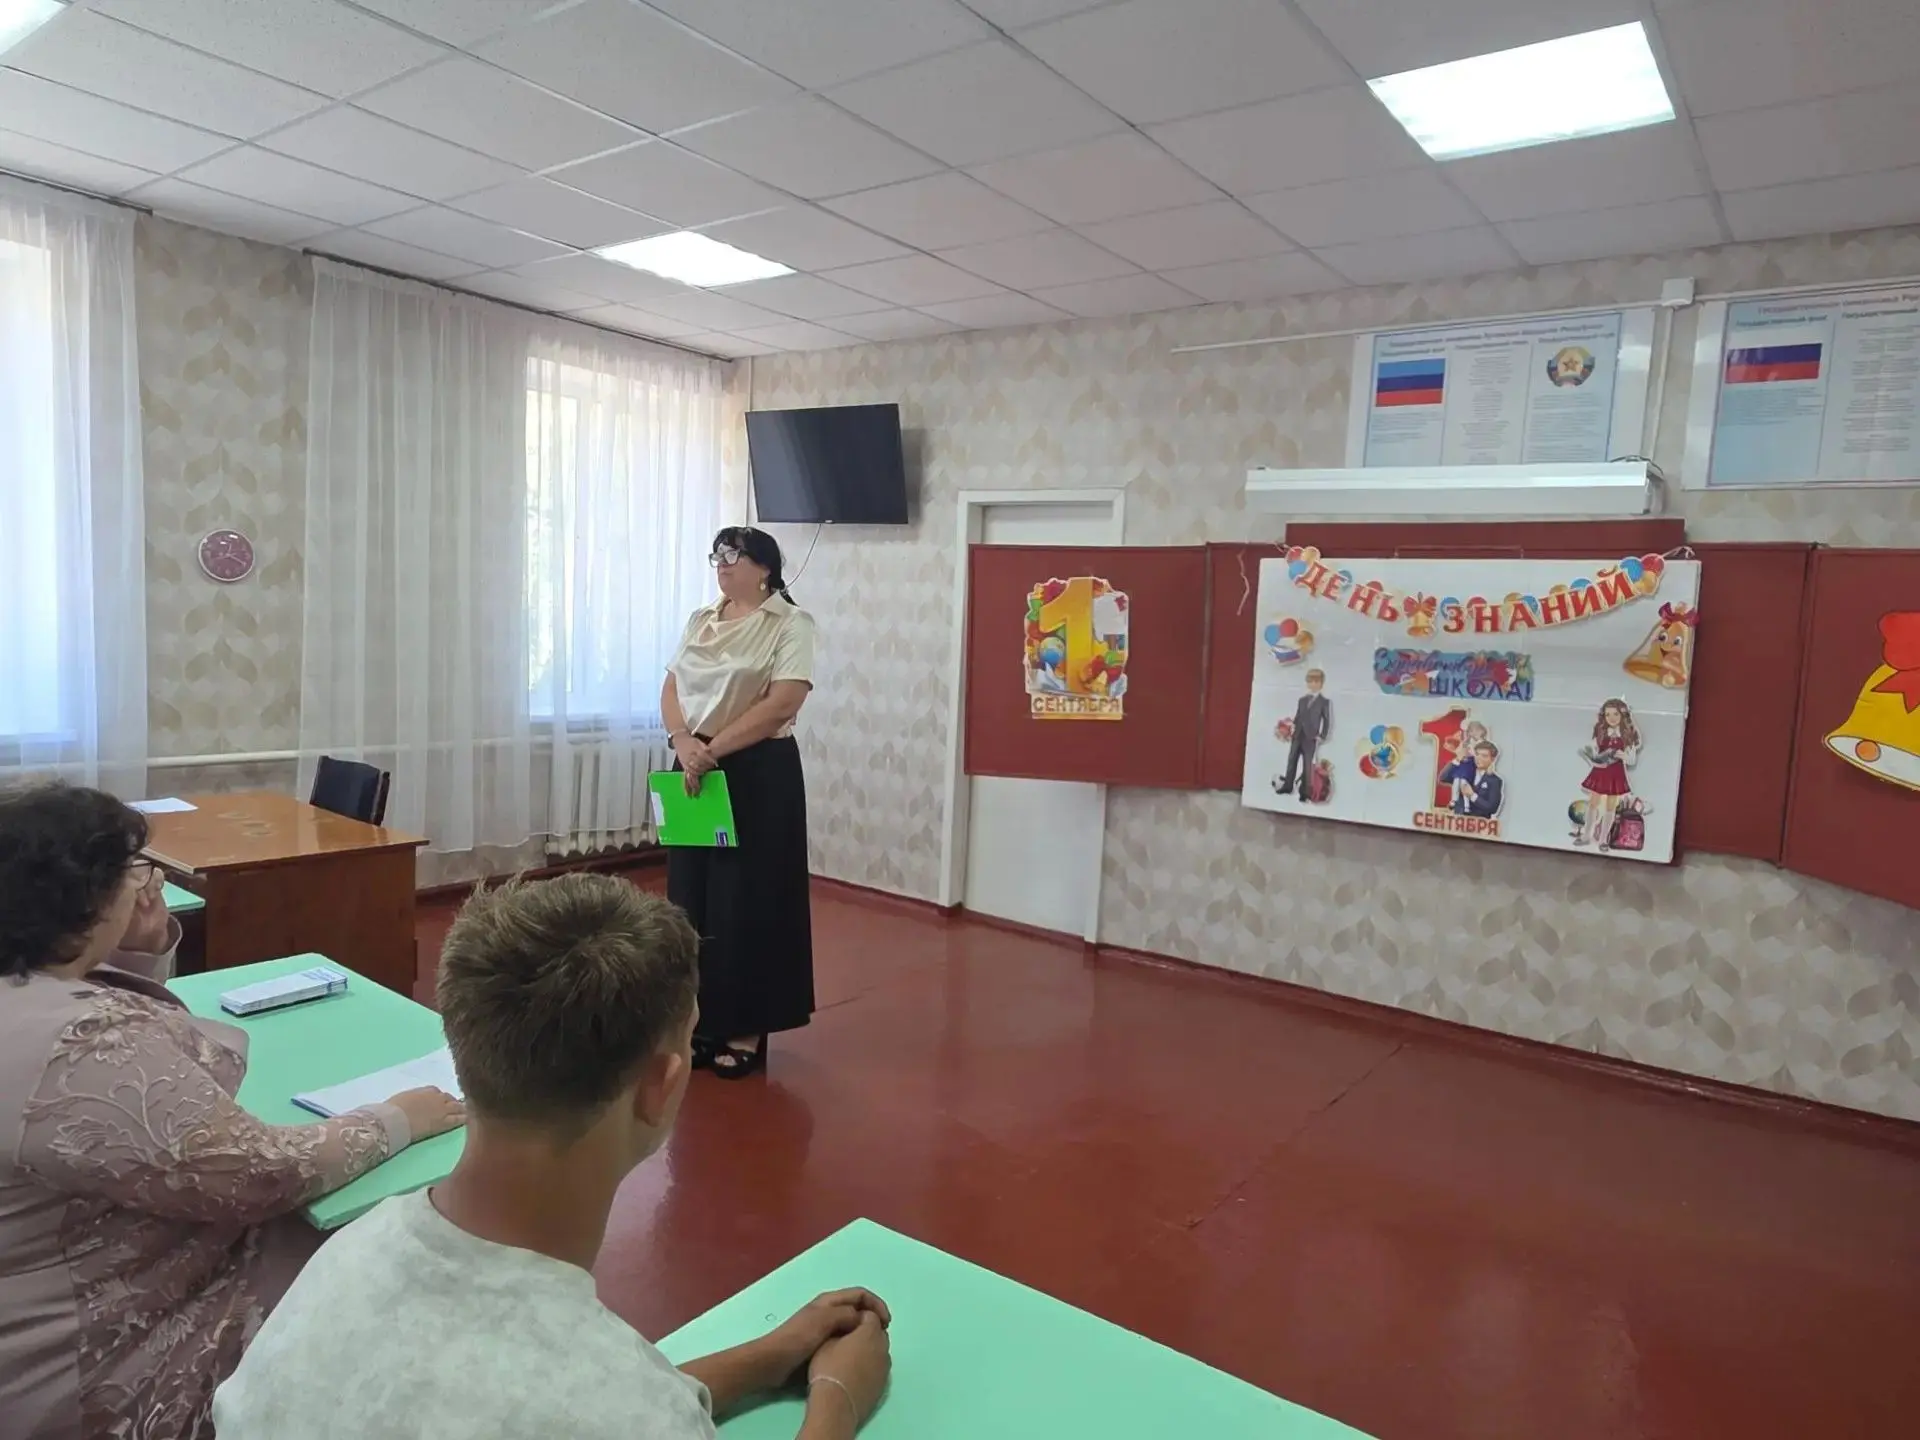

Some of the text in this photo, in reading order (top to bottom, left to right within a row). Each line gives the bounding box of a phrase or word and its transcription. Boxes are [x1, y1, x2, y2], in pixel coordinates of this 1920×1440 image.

[1295, 561, 1636, 634] ДЕНЬ ЗНАНИЙ
[1040, 578, 1093, 692] 1
[1032, 696, 1121, 713] СЕНТЯБРЯ
[1420, 709, 1468, 809] 1
[1413, 811, 1499, 836] СЕНТЯБРЯ
